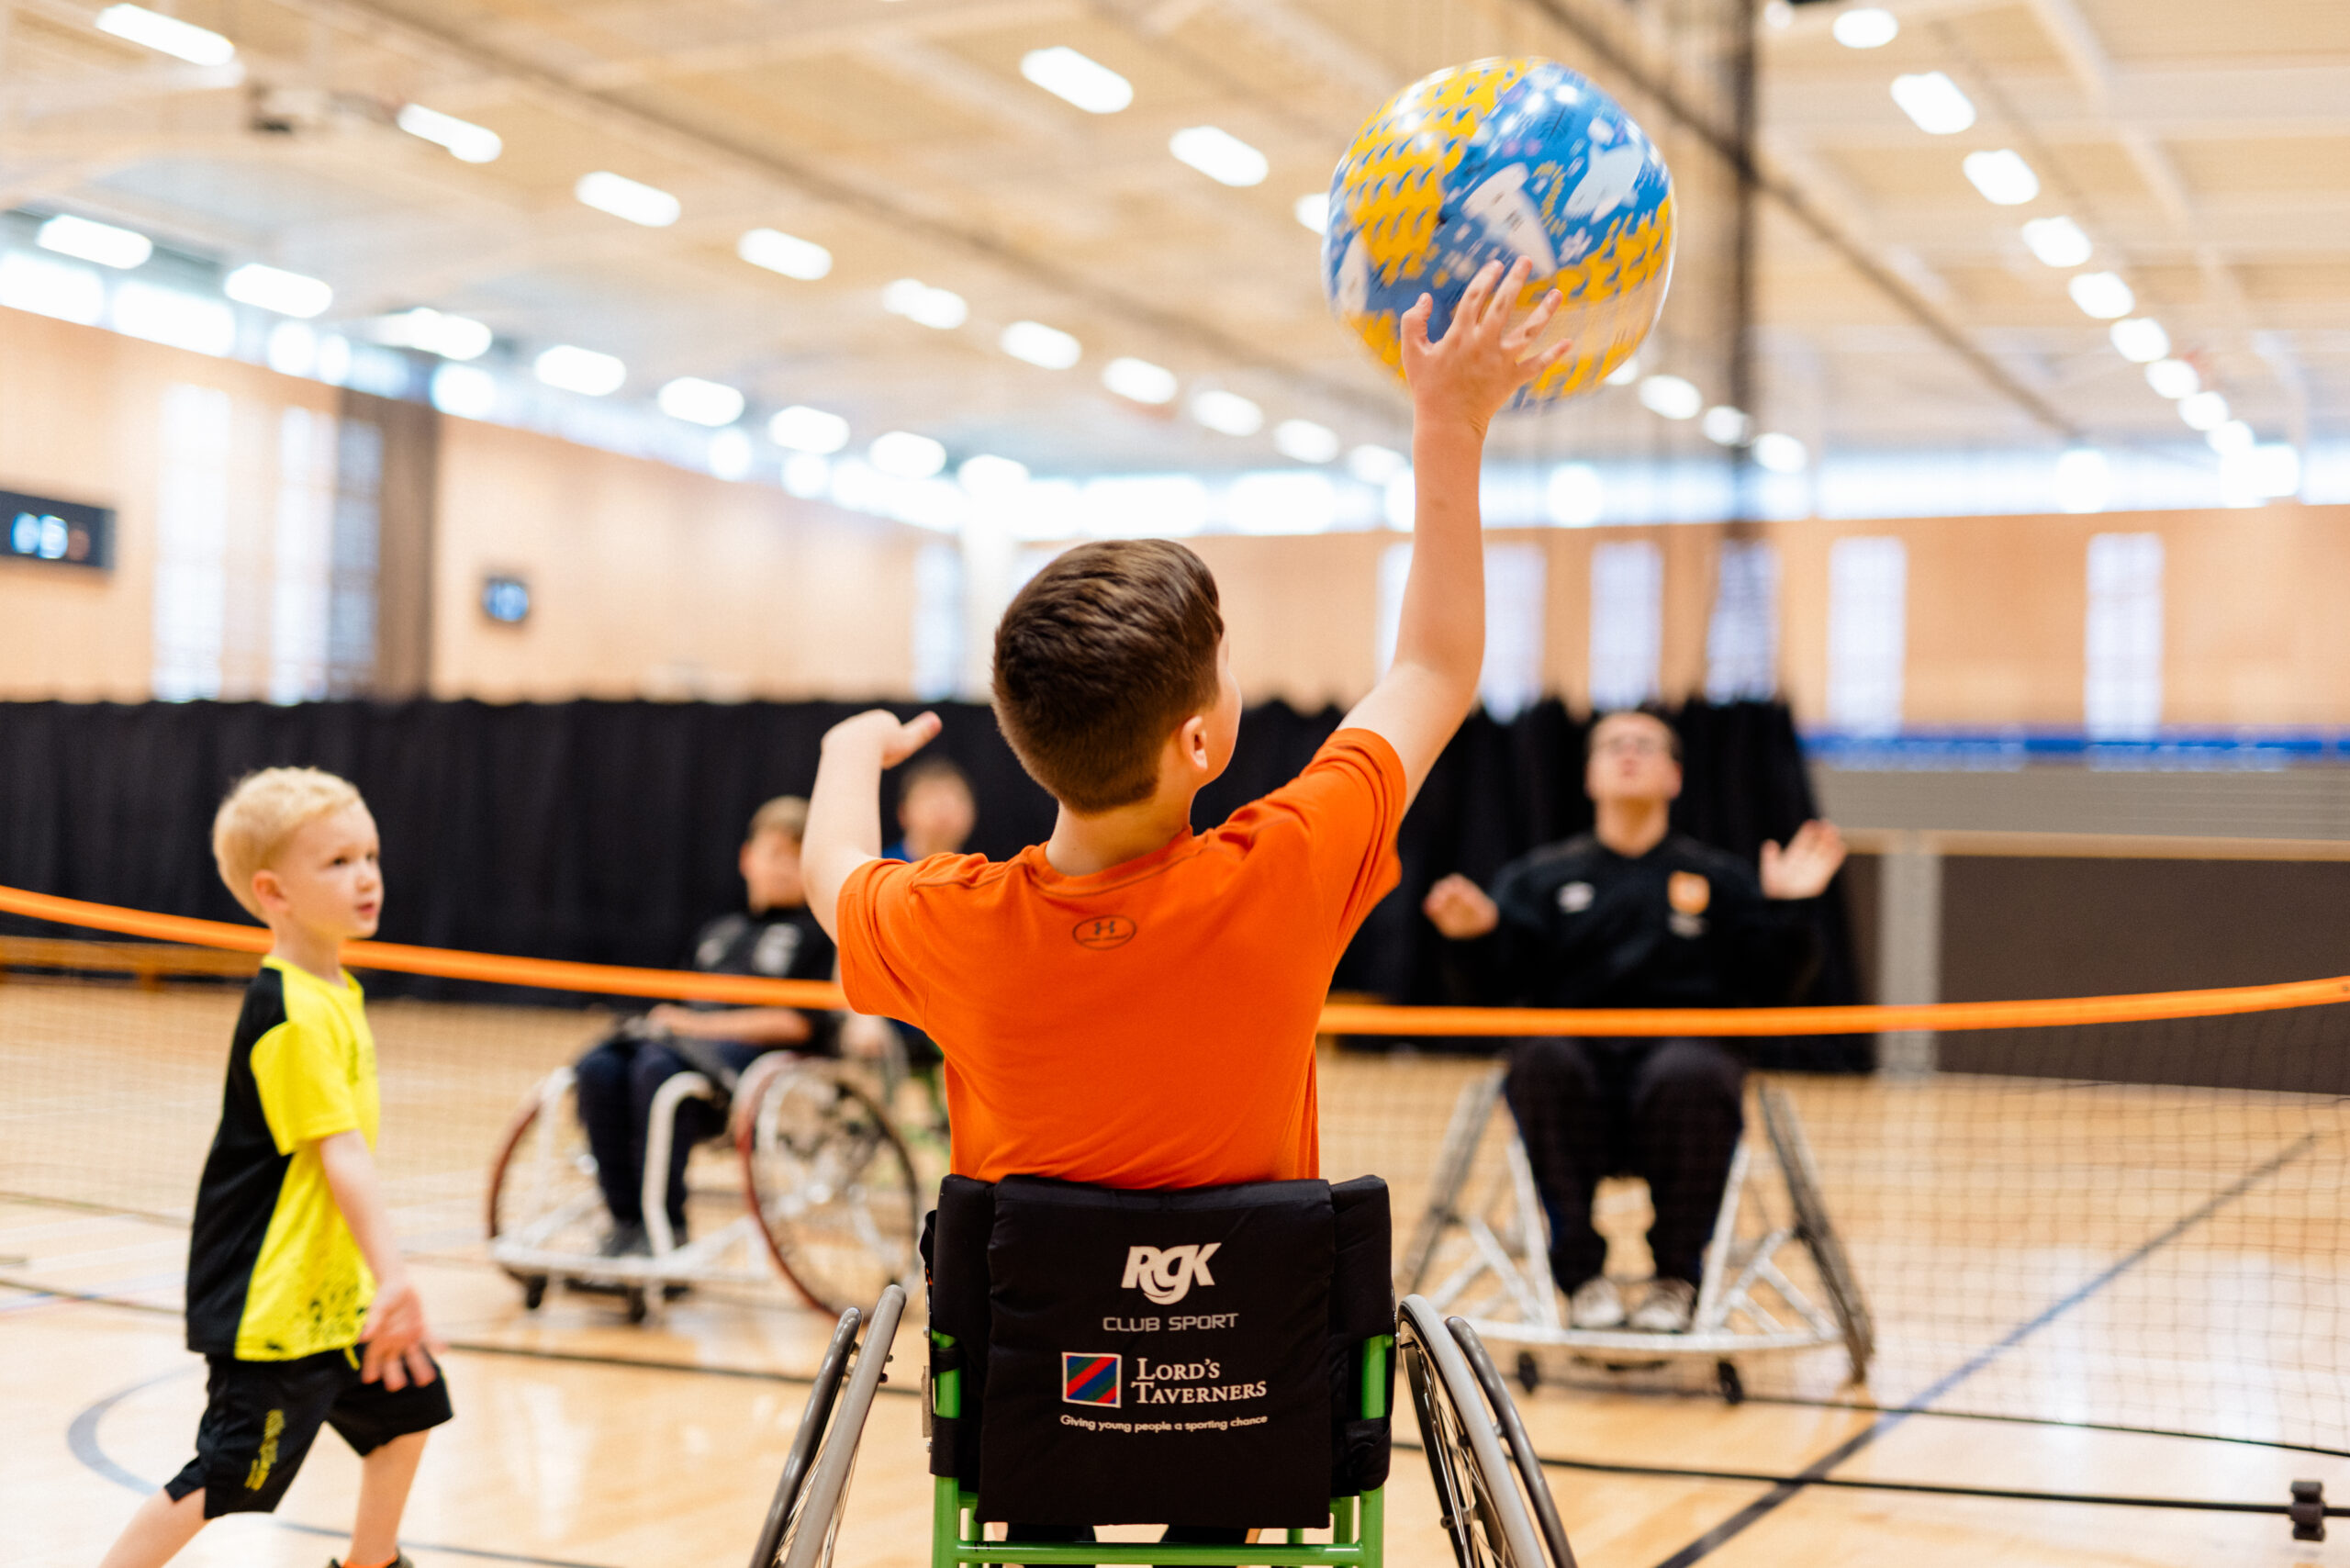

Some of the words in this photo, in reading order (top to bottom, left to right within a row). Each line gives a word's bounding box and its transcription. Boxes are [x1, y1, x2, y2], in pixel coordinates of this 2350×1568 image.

[1102, 1316, 1160, 1332] CLUB
[1168, 1313, 1239, 1331] SPORT
[1136, 1358, 1221, 1381] LORD'S
[1131, 1381, 1268, 1405] TAVERNERS
[1060, 1415, 1096, 1430] Giving
[1098, 1420, 1132, 1432] young
[1135, 1421, 1171, 1433] people
[1174, 1423, 1182, 1431] a
[1185, 1419, 1228, 1432] sporting
[1230, 1415, 1268, 1428] chance
